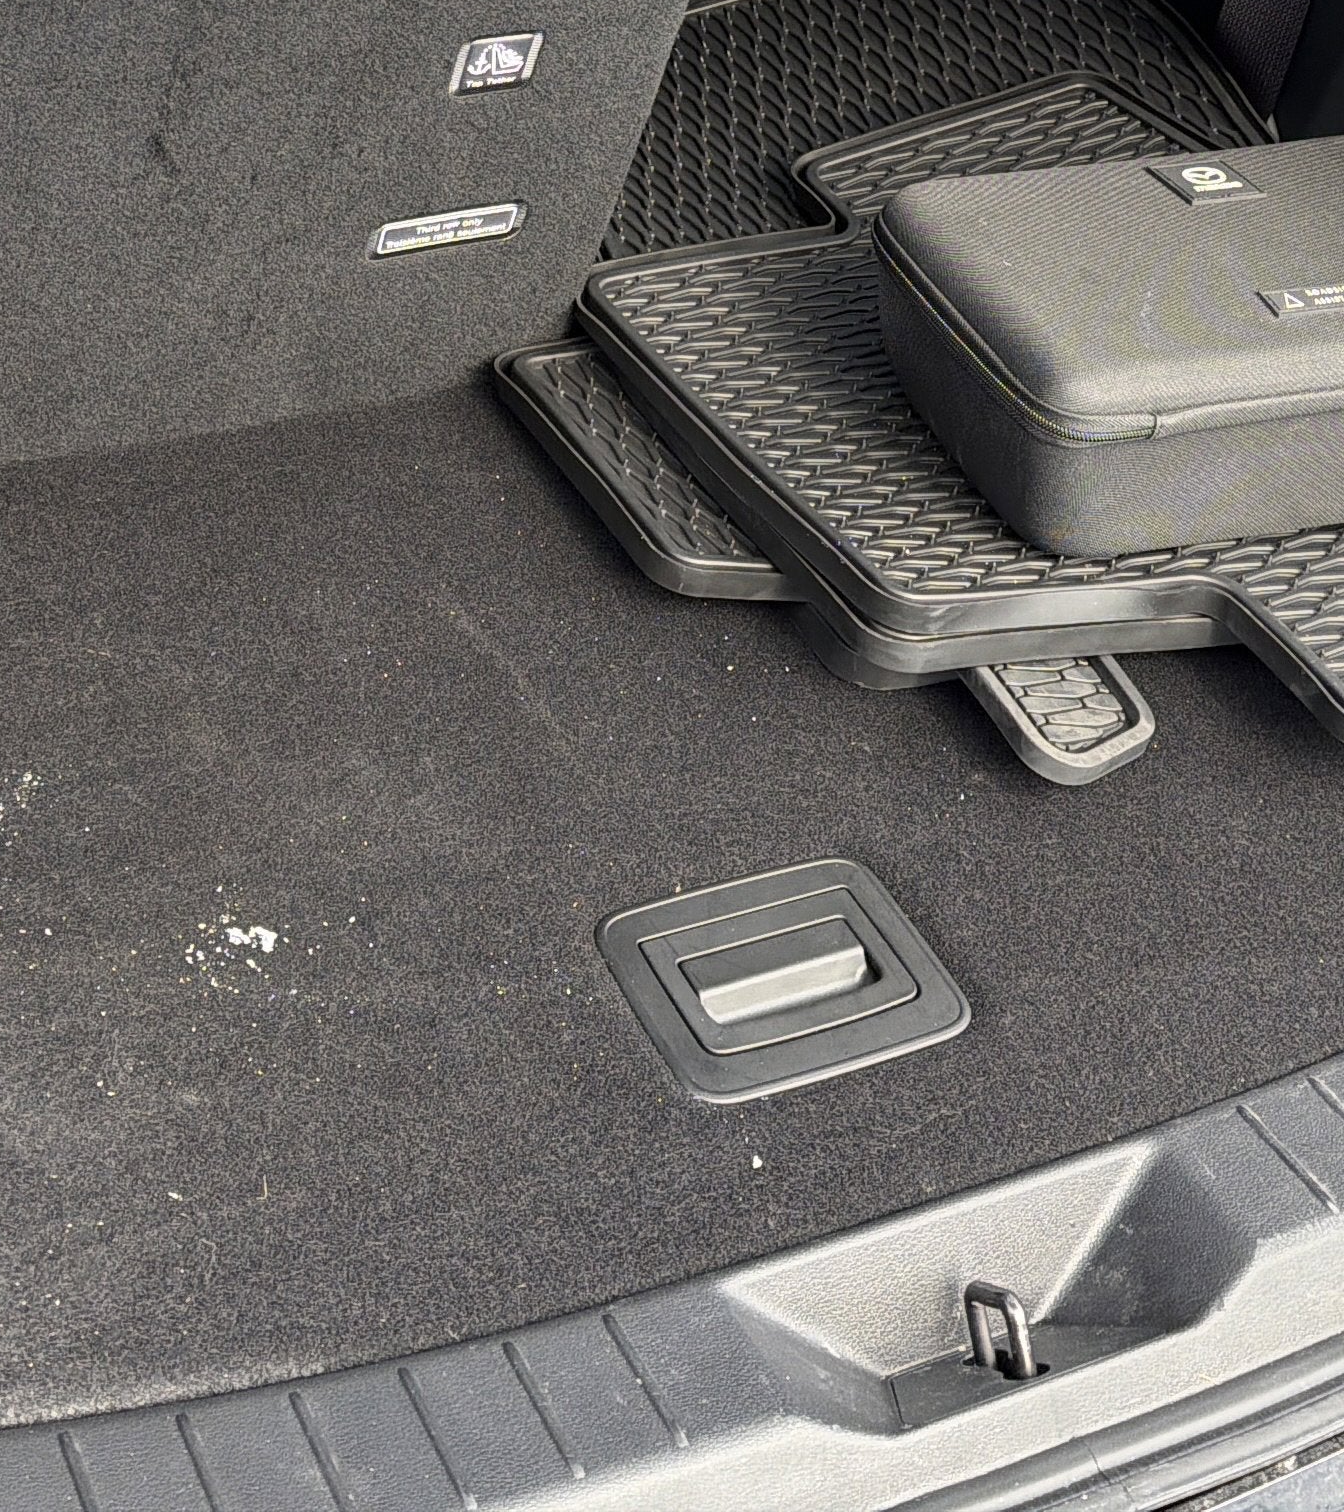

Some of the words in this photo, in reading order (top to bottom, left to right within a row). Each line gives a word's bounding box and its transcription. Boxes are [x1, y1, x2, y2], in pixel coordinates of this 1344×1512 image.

[415, 223, 441, 235] Third
[442, 220, 462, 230] row
[462, 217, 484, 228] only
